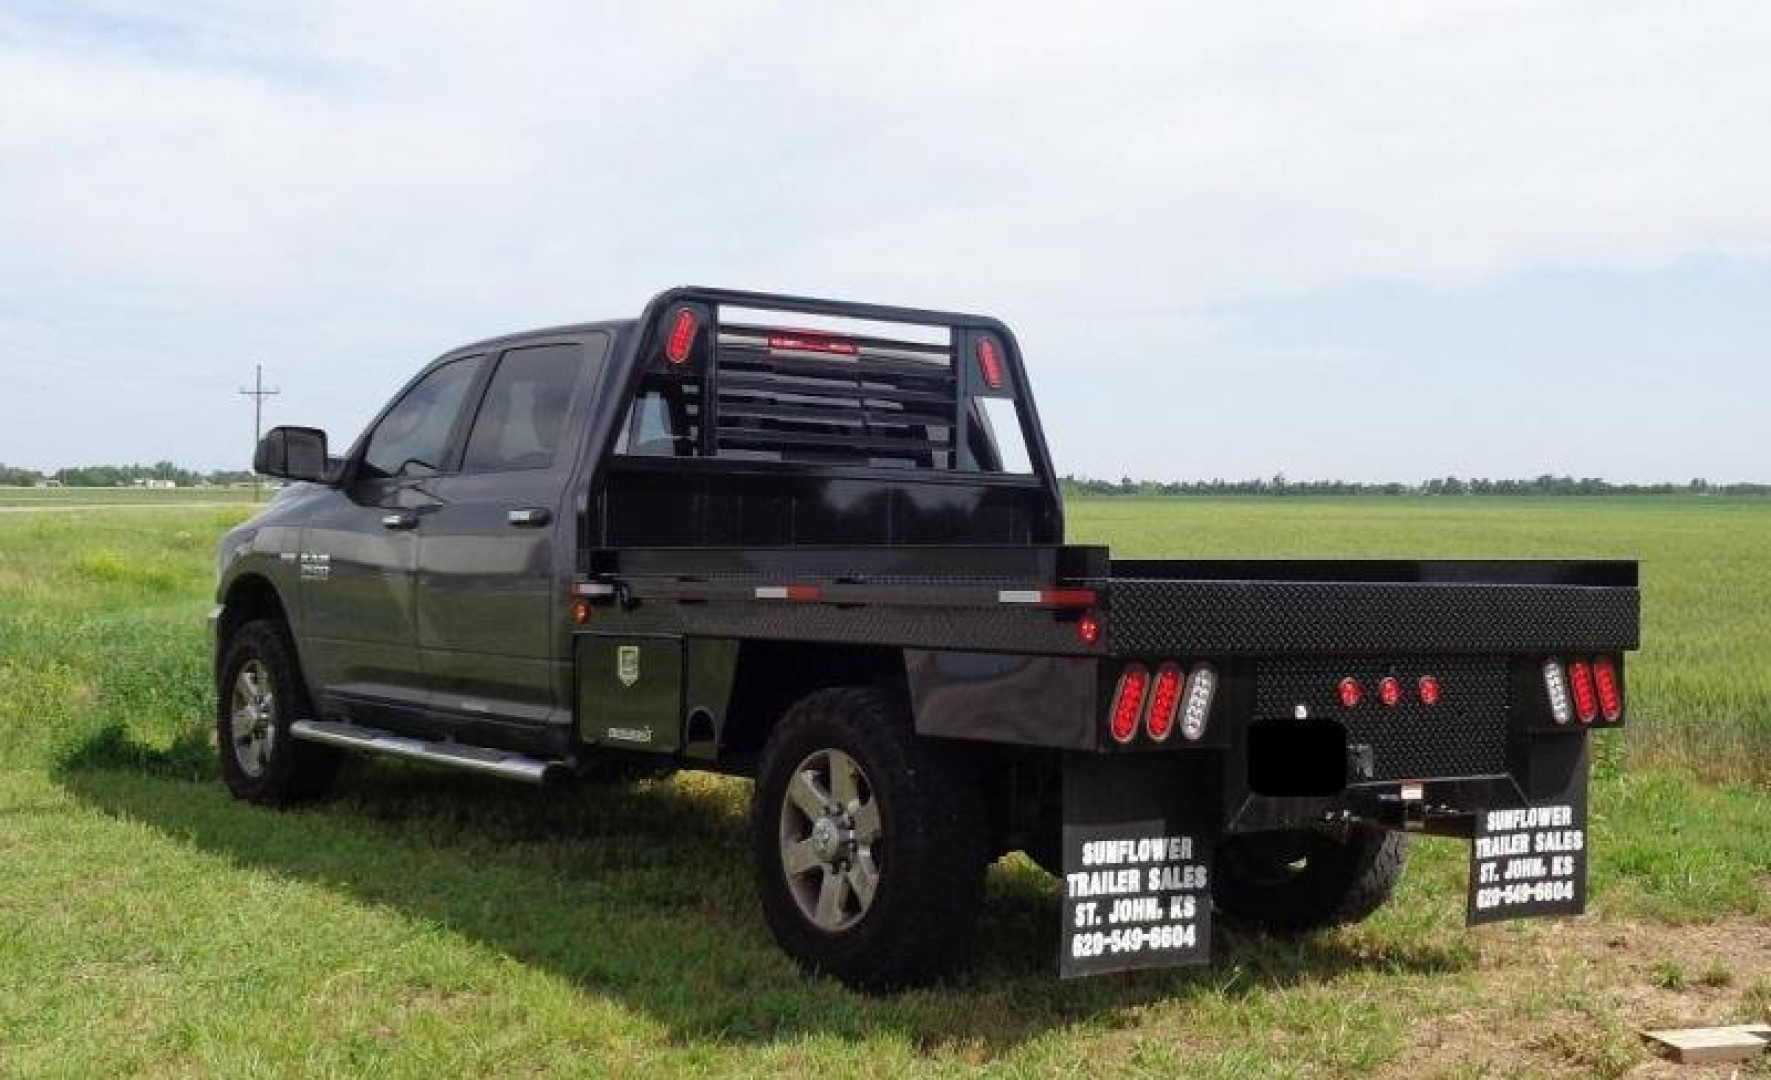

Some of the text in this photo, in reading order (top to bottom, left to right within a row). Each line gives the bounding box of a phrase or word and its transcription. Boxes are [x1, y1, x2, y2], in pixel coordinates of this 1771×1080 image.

[1486, 805, 1572, 832] SUNFLOWER
[1082, 836, 1192, 866] SUNFLOWER
[1476, 830, 1583, 859] TRAILER SALES
[1067, 865, 1207, 898] TRAILER SALES
[1480, 862, 1499, 883] ST.
[1551, 855, 1574, 876] KS
[1075, 902, 1102, 927] ST.
[1170, 895, 1196, 919] KS
[1072, 924, 1196, 958] 620-549-6604
